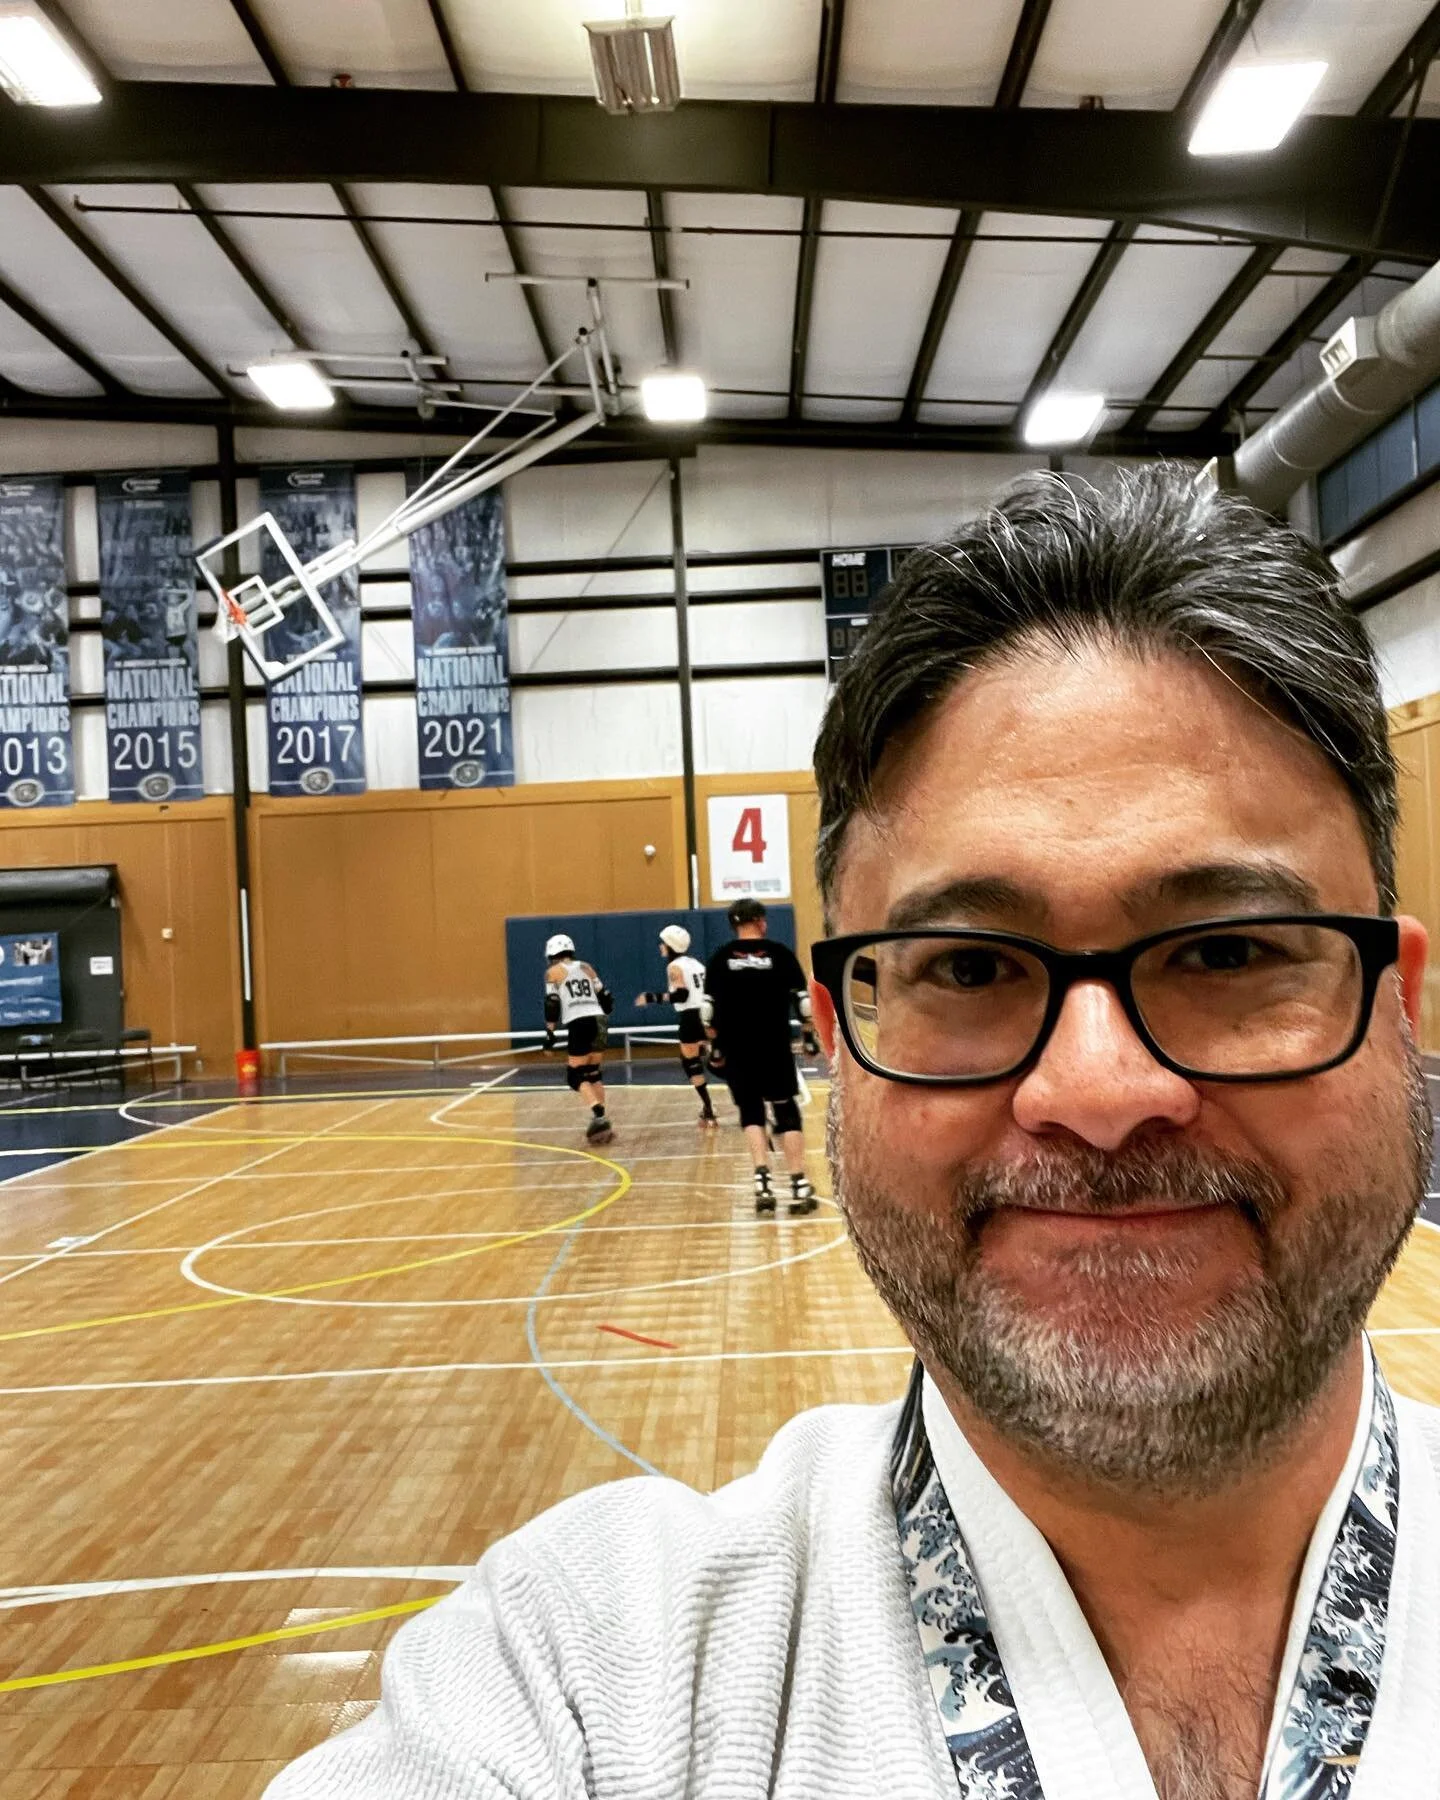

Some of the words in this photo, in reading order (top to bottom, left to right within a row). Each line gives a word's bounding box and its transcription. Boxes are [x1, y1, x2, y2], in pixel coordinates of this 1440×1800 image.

[107, 667, 198, 699] NATIONAL
[272, 661, 358, 693] ATIONAL
[417, 655, 509, 687] NATIONAL
[0, 673, 68, 704] TIONAL
[417, 687, 510, 716] CHAMPIONS
[0, 706, 70, 733] AMPIONS
[108, 701, 200, 730] CHAMPIONS
[271, 695, 360, 723] CHAMPIONS
[113, 731, 198, 771] 2015
[277, 725, 356, 764] 2017
[424, 718, 504, 758] 2021
[0, 737, 68, 776] 013
[732, 808, 767, 863] 4
[565, 978, 592, 998] 138
